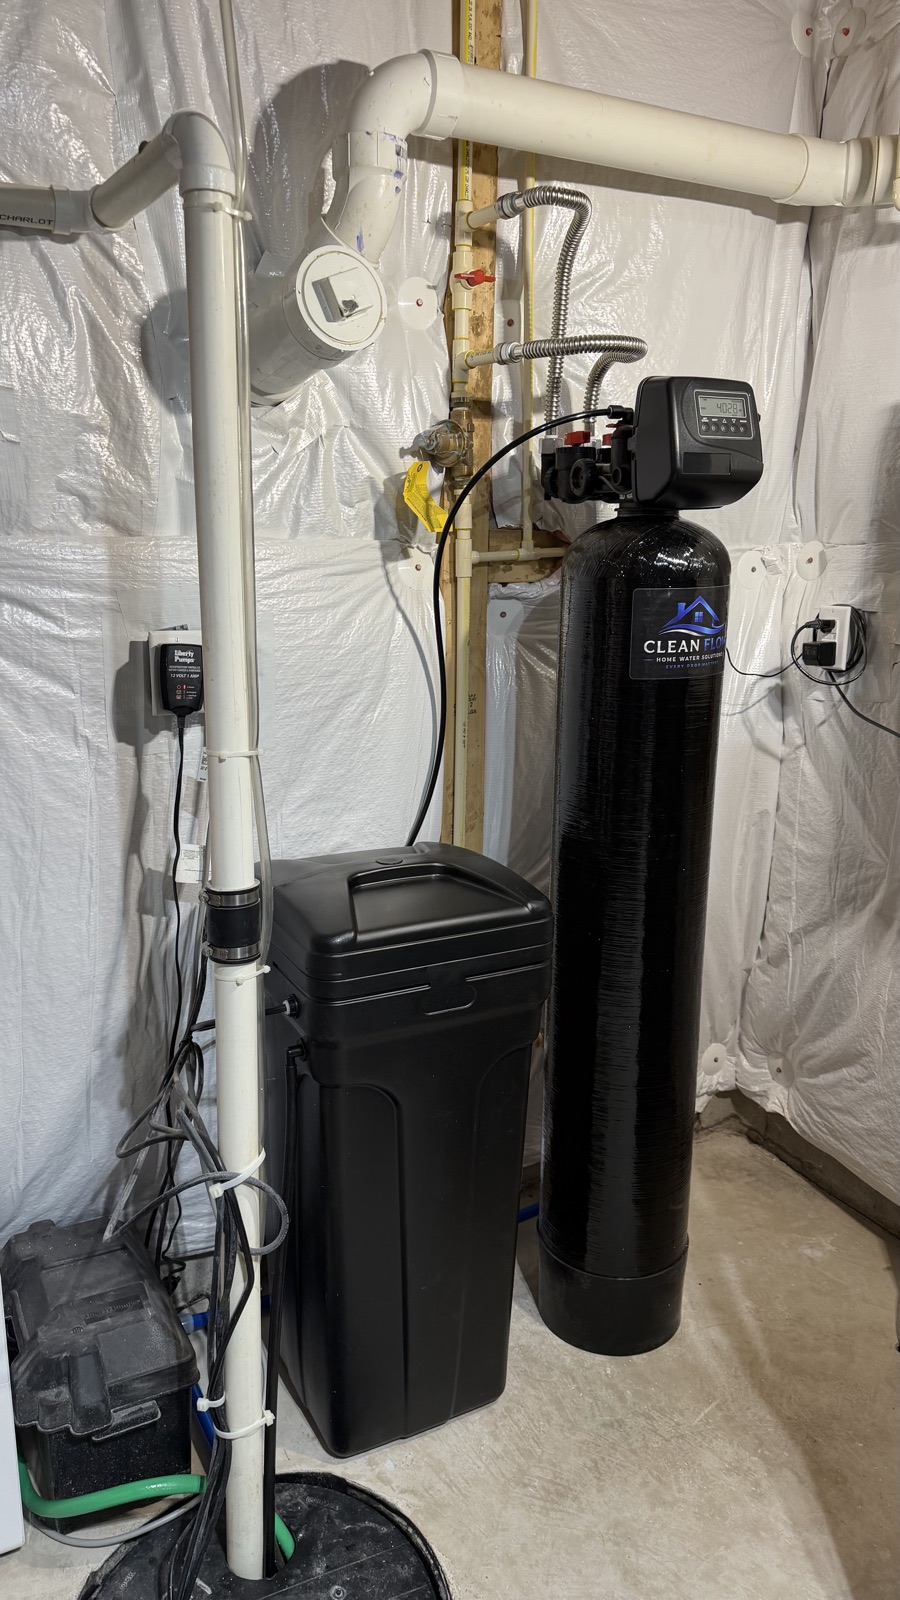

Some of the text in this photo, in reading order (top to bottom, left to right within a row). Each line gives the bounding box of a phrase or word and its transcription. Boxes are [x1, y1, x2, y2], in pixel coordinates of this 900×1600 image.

[643, 639, 700, 654] CLEAN
[174, 649, 195, 658] Liberty
[174, 656, 195, 664] Pumps
[679, 654, 700, 662] WATER
